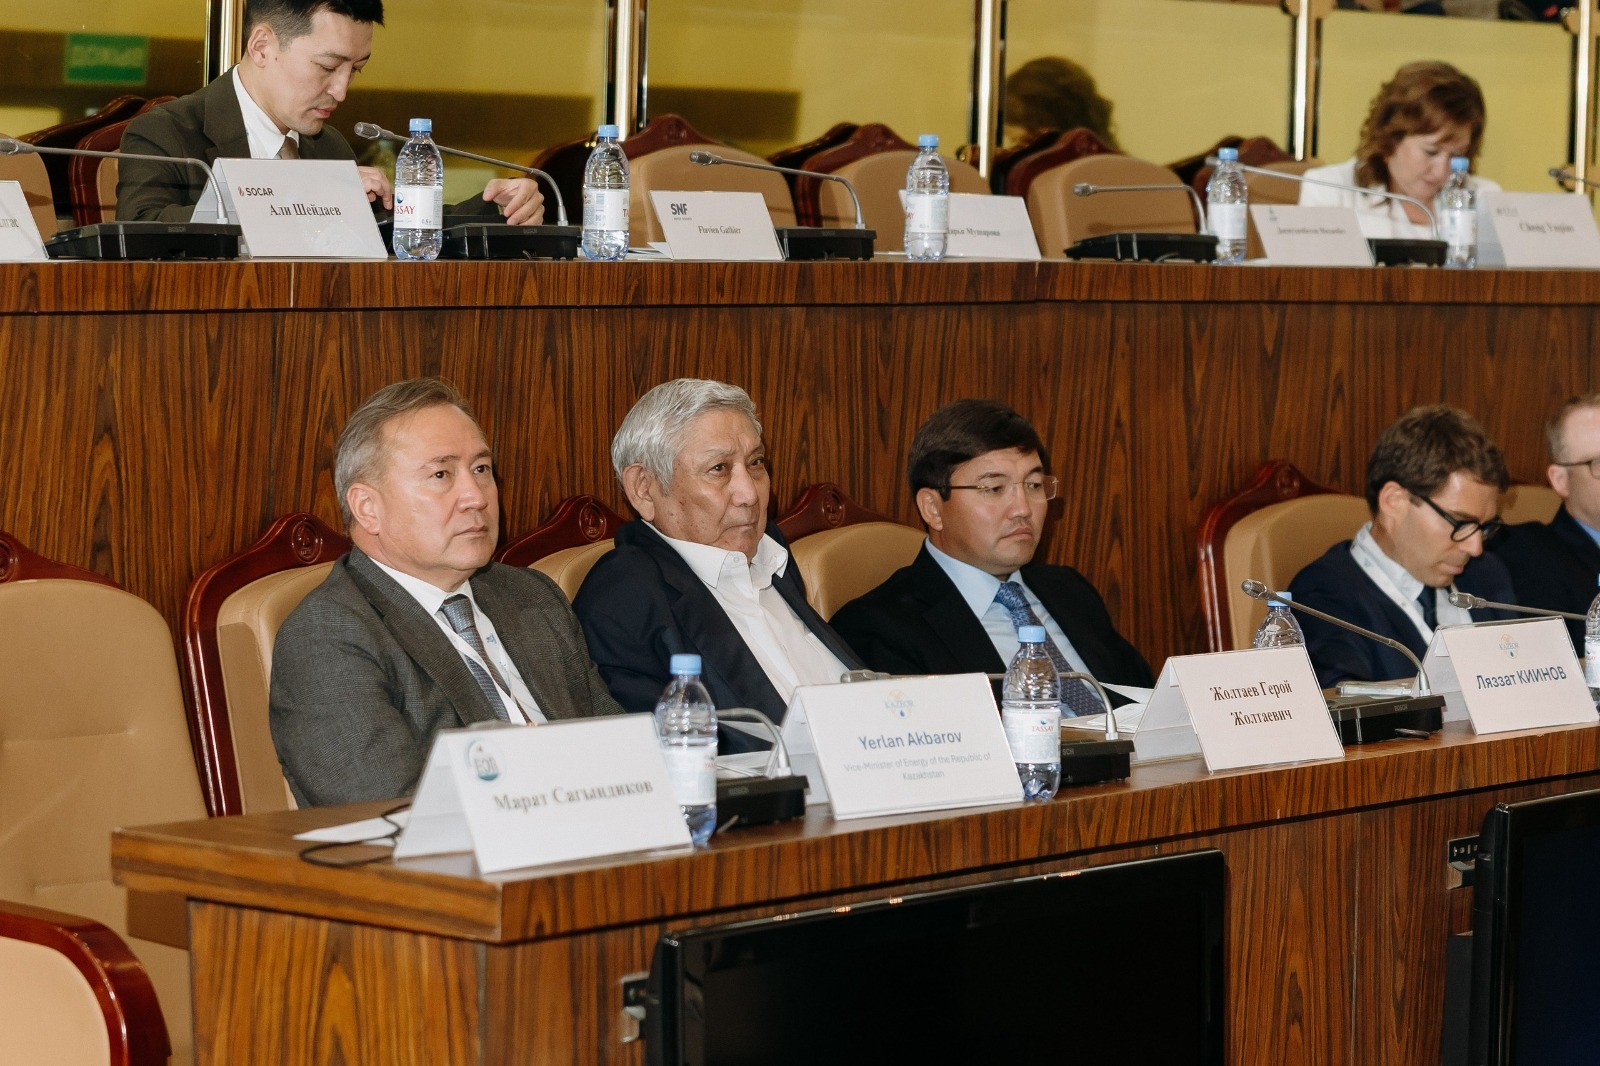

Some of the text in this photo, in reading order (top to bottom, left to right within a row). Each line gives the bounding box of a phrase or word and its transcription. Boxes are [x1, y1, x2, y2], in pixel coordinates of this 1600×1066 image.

[246, 187, 274, 196] SOCAR
[270, 203, 342, 217] Али Шейдаев
[670, 203, 688, 215] SNF
[1476, 666, 1567, 690] Ляззат КИИНОВ
[1209, 679, 1293, 701] Жолтаев Герой
[1230, 709, 1293, 726] Жолтаевич
[858, 731, 963, 750] Yerlan Akbarov
[843, 752, 992, 772] Vice-Minister of Energy of the Republic of
[902, 769, 945, 781] Kazakhstan
[494, 780, 654, 814] Марат Сагындиков
